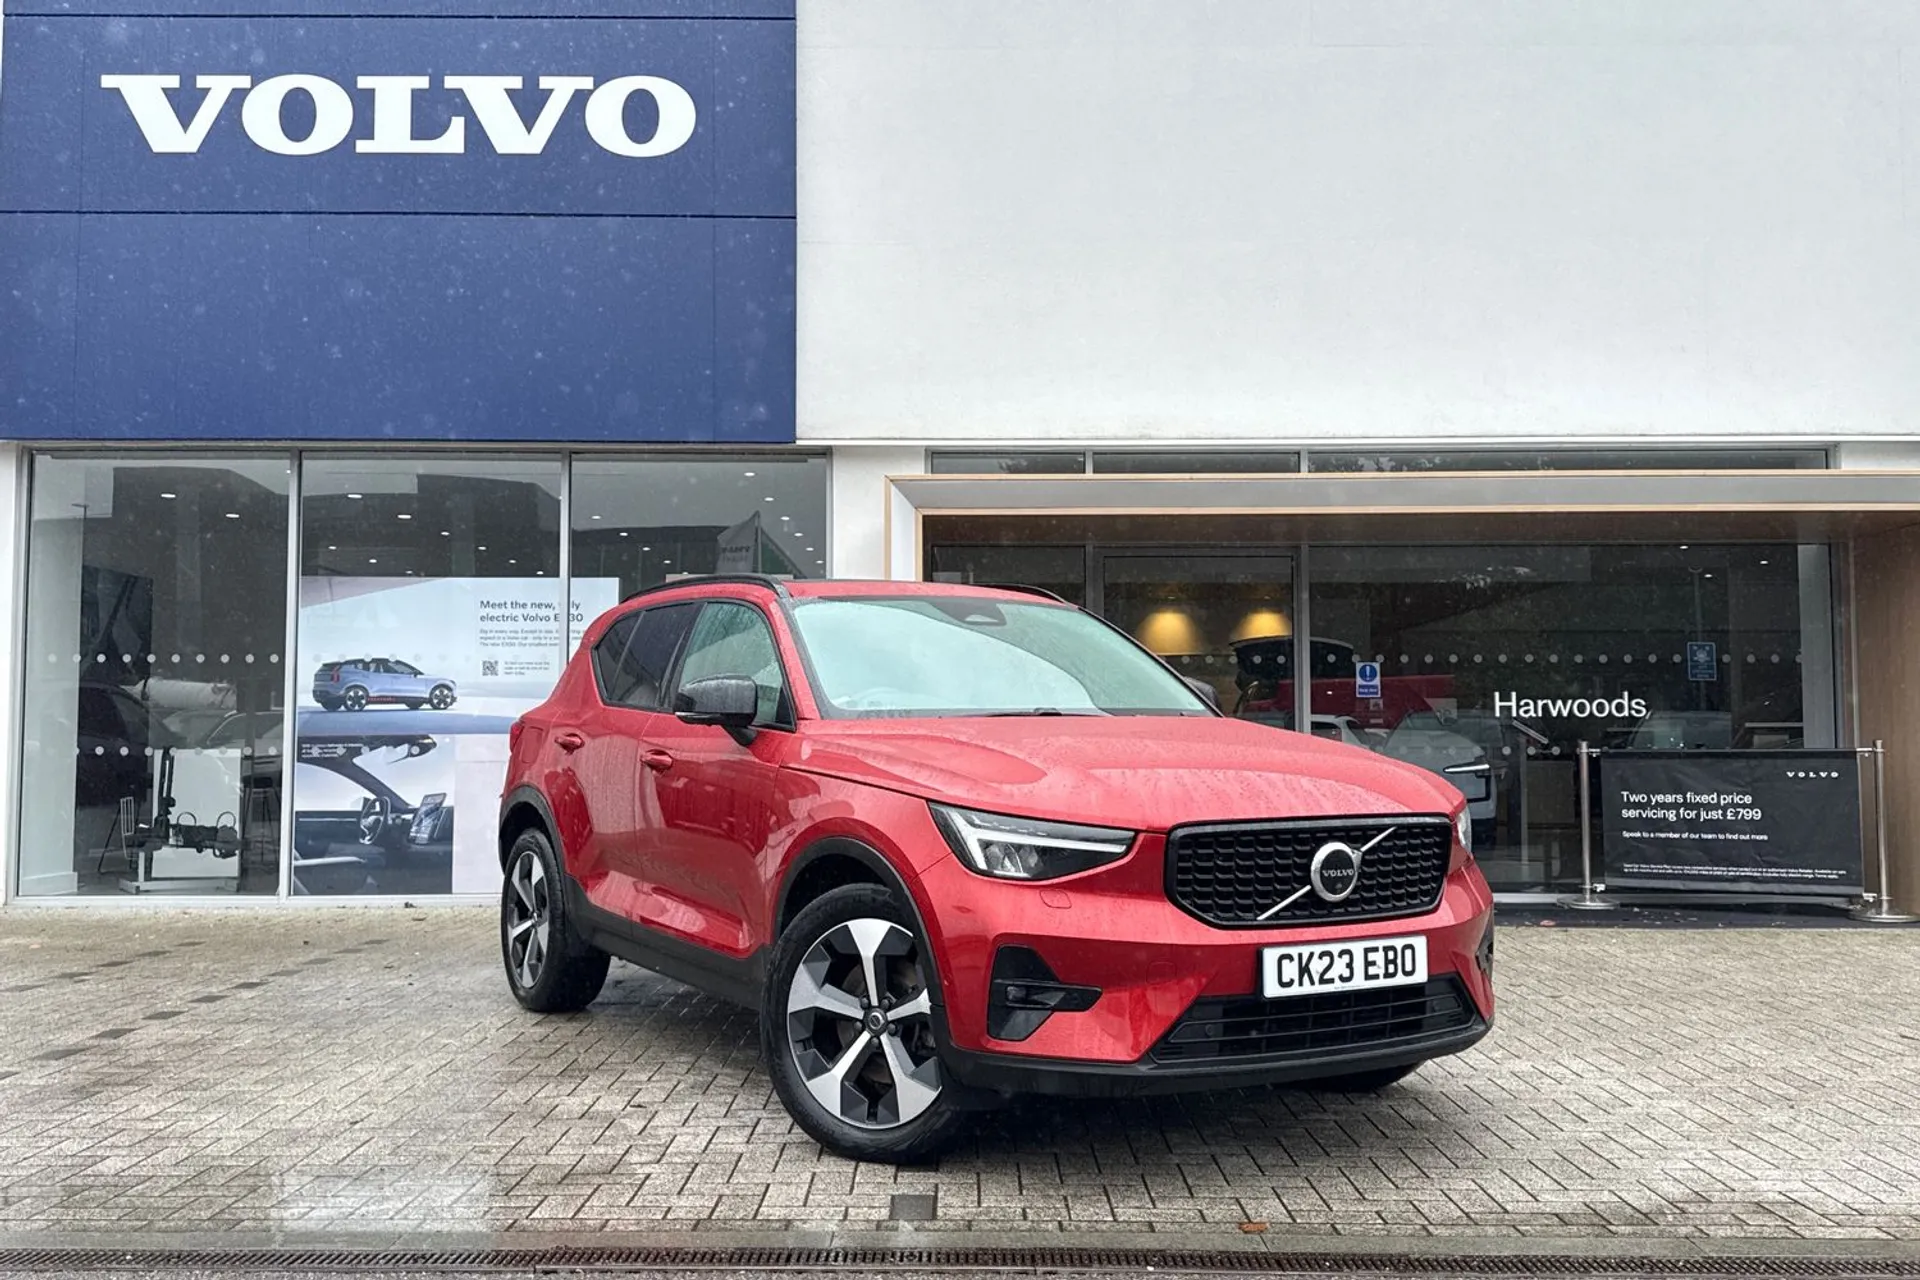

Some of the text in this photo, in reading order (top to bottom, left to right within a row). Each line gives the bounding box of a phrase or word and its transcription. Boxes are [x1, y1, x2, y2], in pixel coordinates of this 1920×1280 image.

[101, 74, 696, 157] VOLVO
[480, 600, 509, 609] Meet
[511, 600, 528, 609] the
[530, 602, 556, 611] new,
[479, 613, 584, 622] electric Volvo E30
[1494, 691, 1647, 718] Harwoods
[1621, 791, 1752, 806] Two years fixed price
[1621, 807, 1762, 822] servicing for just £799
[1622, 830, 1641, 839] Speak
[1655, 831, 1681, 839] member
[1681, 831, 1689, 839] of
[1701, 832, 1717, 840] team
[1718, 832, 1725, 840] to
[1726, 832, 1738, 840] find
[1322, 869, 1354, 877] VOLVO
[1277, 943, 1416, 989] CK23 EBO
